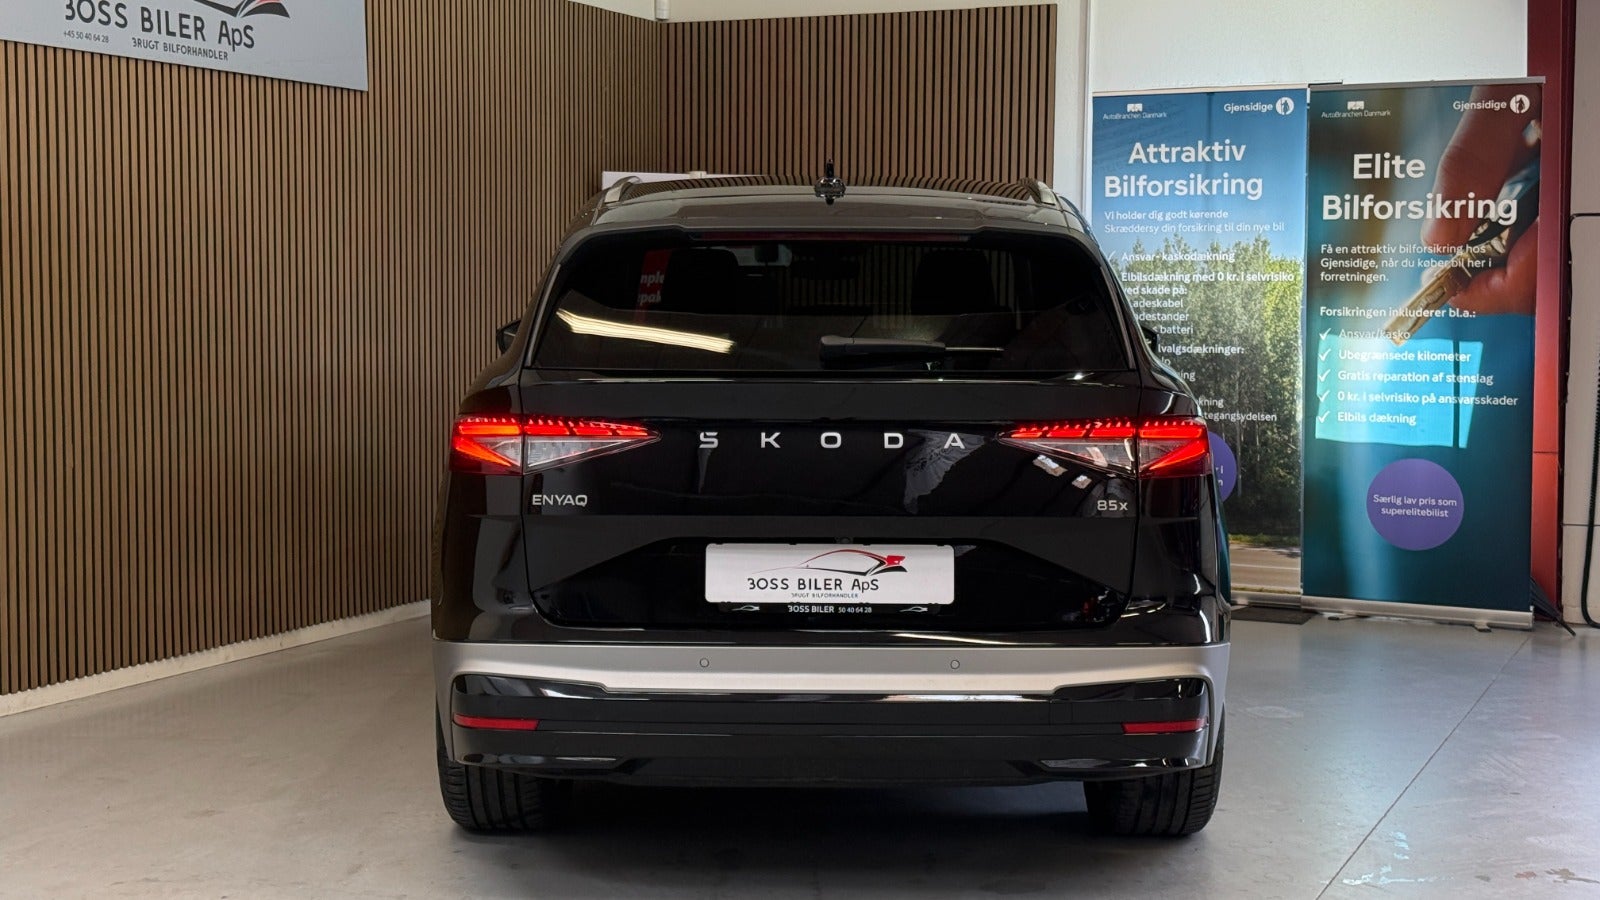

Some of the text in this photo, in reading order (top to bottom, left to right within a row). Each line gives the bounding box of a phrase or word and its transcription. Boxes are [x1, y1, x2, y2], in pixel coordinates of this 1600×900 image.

[140, 6, 206, 42] BILER
[218, 20, 255, 52] ApS
[63, 30, 110, 43] +45 50 40 64 28
[163, 42, 228, 60] BILFORHANDLER
[1223, 102, 1273, 114] Gjensidige
[1452, 100, 1507, 111] Gjensidige
[1128, 139, 1246, 164] Attraktiv
[1353, 152, 1426, 180] Elite
[1104, 172, 1263, 200] Bilforsikring
[1322, 191, 1518, 225] Bilforsikring
[1104, 210, 1229, 221] Vi holder dig godt kørende
[1104, 222, 1285, 235] Skræddersy din forsikring til din nye bil
[1320, 243, 1333, 254] Få
[1350, 244, 1397, 254] attraktiv
[1399, 244, 1463, 256] bilforsikring
[1465, 244, 1486, 254] hos
[1161, 251, 1235, 264] kaskodækning
[1320, 258, 1379, 270] Gjensidige,
[1381, 257, 1399, 268] når
[1401, 258, 1415, 268] du
[1417, 258, 1450, 268] køber
[1451, 258, 1464, 268] bil
[1468, 258, 1486, 268] her
[1121, 272, 1191, 284] Elbilsdækning
[1193, 272, 1215, 282] med
[1217, 272, 1224, 281] 0
[1226, 271, 1240, 281] kr.
[1246, 272, 1295, 282] selvrisiko
[1320, 272, 1389, 283] forretningen.
[1141, 285, 1171, 295] skade
[1172, 285, 1188, 298] på:
[1130, 298, 1184, 308] adeskabel
[1320, 306, 1476, 318] Forsikringen inkluderer bl.a.:
[1160, 325, 1194, 335] batteri
[1339, 329, 1411, 340] Ansvar/kasko
[1339, 350, 1472, 363] Ubegrænsede kilometer
[1338, 370, 1494, 386] Gratis reparation af stenslag
[1337, 391, 1345, 401] 0
[1347, 391, 1360, 401] kr.
[1368, 391, 1419, 403] selvrisiko
[1421, 392, 1436, 405] på
[1438, 394, 1518, 406] ansvarsskader
[1337, 412, 1416, 426] Elbils dækning
[532, 494, 588, 508] ENYAQ
[1373, 494, 1402, 506] Særlig
[1404, 495, 1417, 505] lav
[1419, 496, 1436, 507] pris
[1381, 507, 1449, 517] superelitebilist
[798, 578, 843, 591] BILER
[851, 578, 879, 593] ApS
[811, 605, 835, 613] BILER
